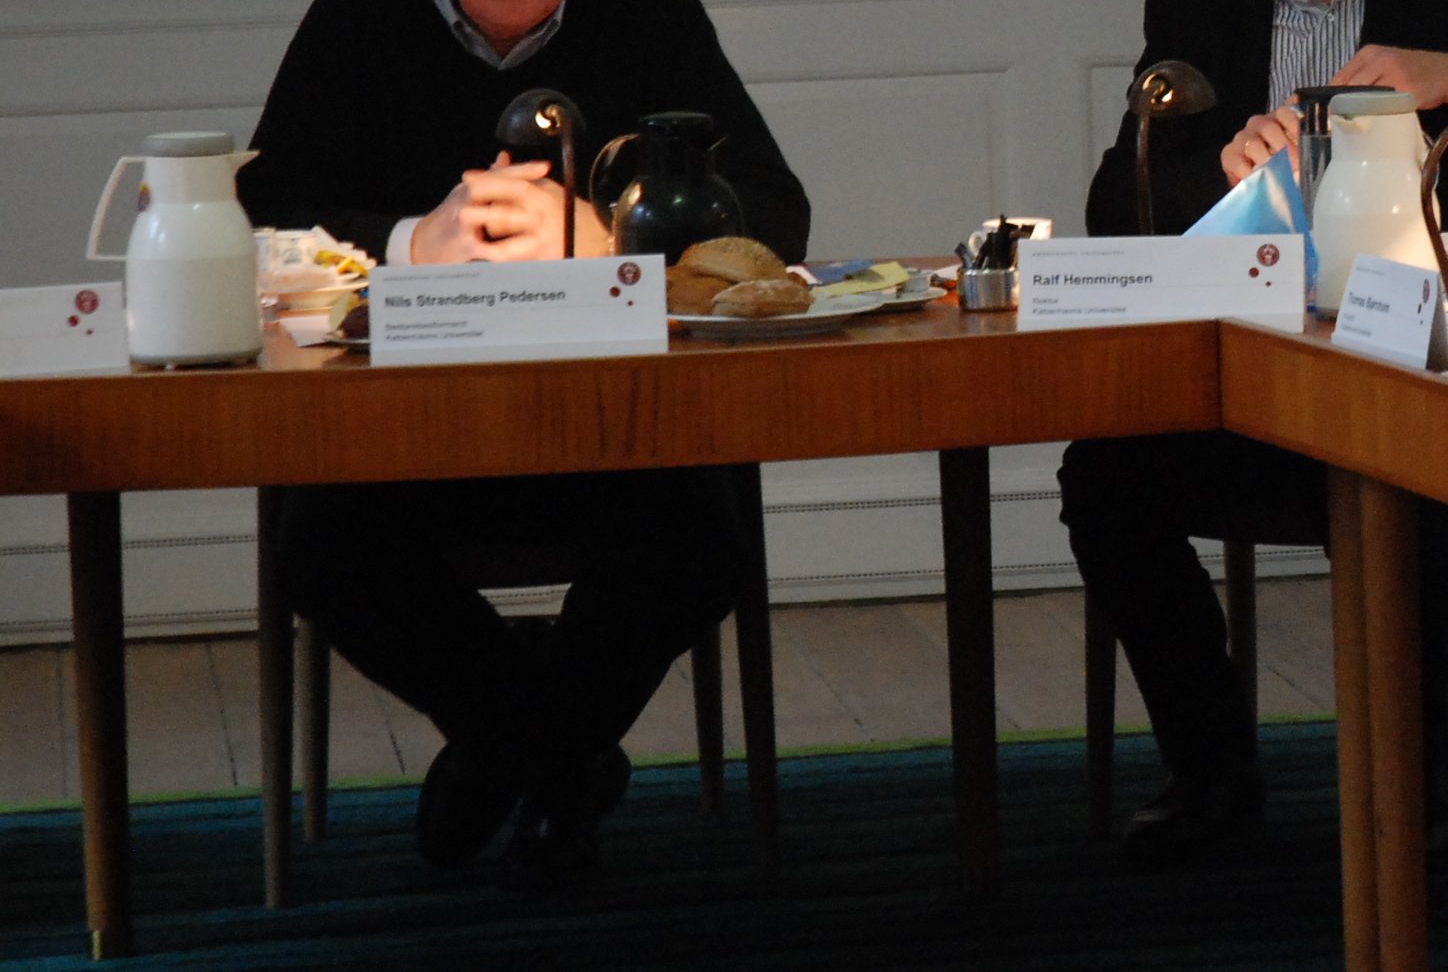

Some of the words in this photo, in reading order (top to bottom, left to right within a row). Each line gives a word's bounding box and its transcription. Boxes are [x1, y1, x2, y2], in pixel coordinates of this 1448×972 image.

[1032, 274, 1060, 286] Ralf
[1063, 274, 1153, 288] Hemmingsen
[384, 295, 412, 308] Nils
[416, 292, 496, 308] Strandberg
[499, 290, 566, 304] Pedersen
